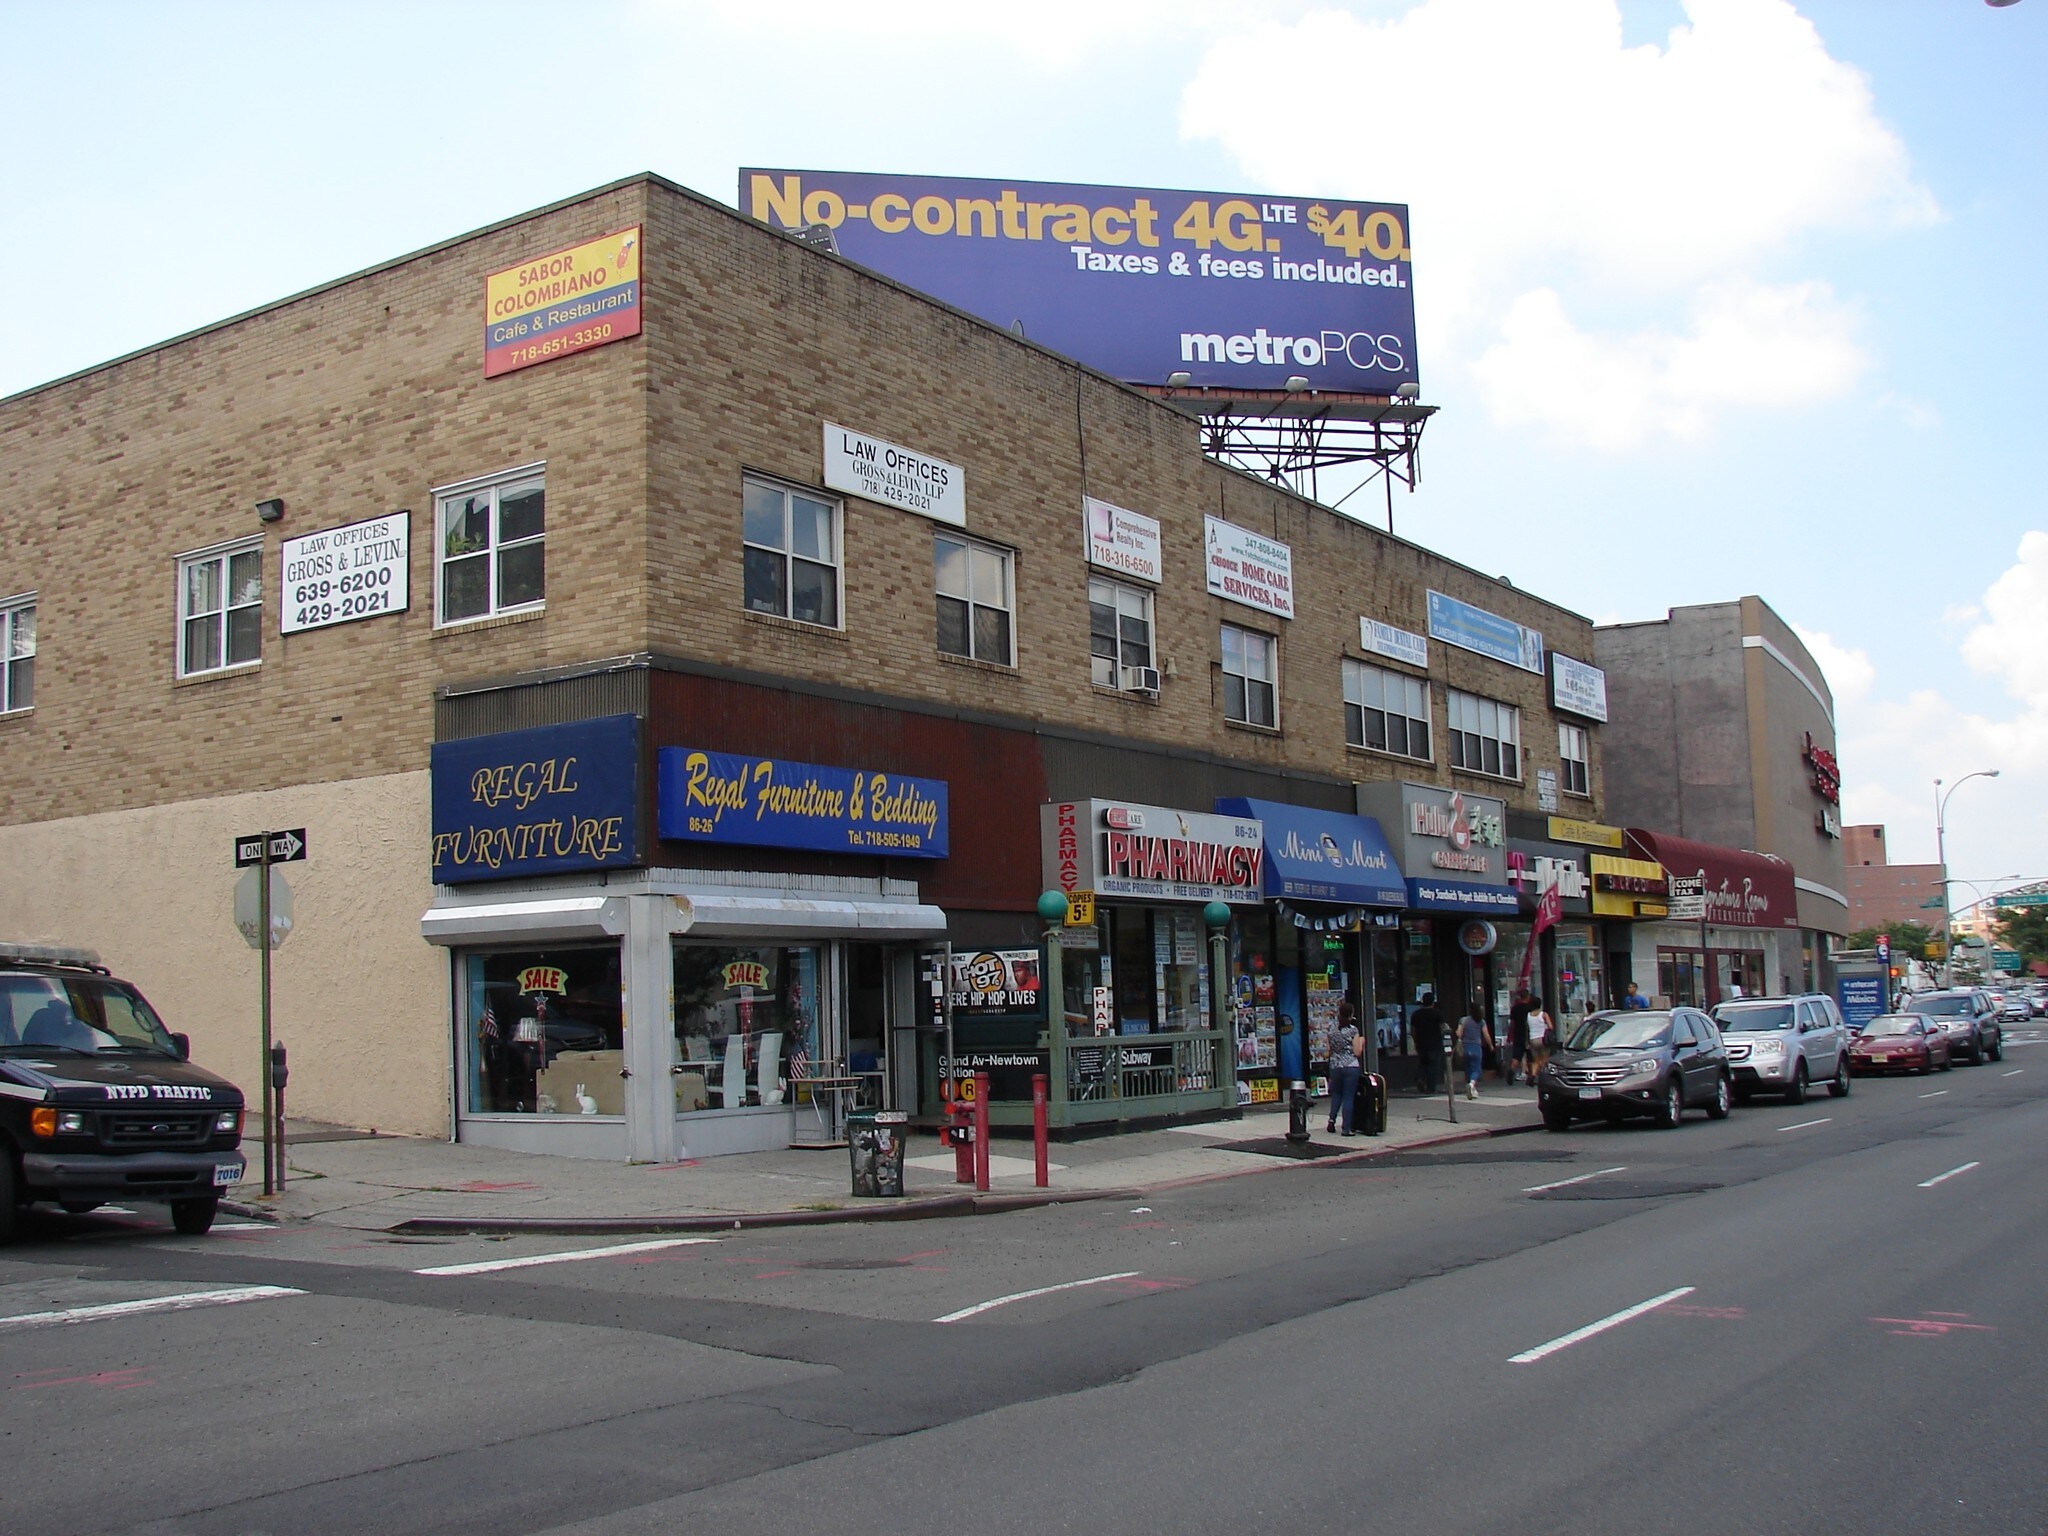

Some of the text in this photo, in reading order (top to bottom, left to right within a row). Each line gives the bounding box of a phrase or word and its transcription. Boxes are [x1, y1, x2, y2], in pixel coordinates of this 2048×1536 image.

[751, 175, 1411, 262] No-contract 4G. LTE $40.
[519, 255, 573, 287] SABOR
[1071, 245, 1405, 289] Taxes & fees included.
[494, 267, 607, 316] COLOMBIANO
[494, 289, 632, 343] Cafe & Restaurant
[511, 324, 612, 364] 718-651-3330
[843, 433, 948, 486] LAW OFFICES
[861, 479, 930, 510] (718) 429-2021
[925, 483, 944, 500] LLP
[301, 522, 389, 555] LAW OFFICES
[1116, 517, 1157, 541] Comprehensive
[1116, 531, 1146, 550] Realty Inc.
[287, 554, 333, 582] GROSS
[338, 552, 348, 571] &
[354, 538, 401, 567] LEVIN
[1094, 545, 1153, 576] 718-316-6500
[296, 567, 392, 603] 639-6200
[1211, 555, 1289, 592] CHOICE HOME CARE
[1224, 576, 1290, 611] SERVICES, Inc.
[297, 590, 389, 625] 429-2021
[471, 757, 578, 810] REGAL
[685, 753, 938, 839] Regal Furniture & Bedding
[689, 817, 713, 833] 86-26
[1234, 825, 1258, 840] 86-24
[245, 839, 295, 857] ON WAY
[432, 815, 623, 869] FURNITURE
[848, 830, 920, 848] Tel. 718-505-1949
[1058, 805, 1077, 892] PHARMACY
[1278, 830, 1387, 870] Mini Mart
[1107, 832, 1262, 887] PHARMACY
[1103, 880, 1131, 893] ORGANIC
[1132, 882, 1163, 895] PRODUCTS
[1173, 885, 1187, 896] FREE
[1188, 886, 1213, 899] DELIVERY
[1675, 888, 1694, 896] TAX
[1676, 878, 1702, 888] COME
[1068, 894, 1092, 904] COPIES
[524, 967, 559, 991] SALE
[728, 961, 762, 987] SALE
[960, 957, 999, 981] HOT
[976, 971, 1001, 988] 97
[949, 989, 1036, 1006] ERE HIP HOP LIVES
[1095, 989, 1106, 1037] PHAR
[939, 1054, 1039, 1066] Gand Av-Newtown
[1122, 1050, 1151, 1065] Subway
[939, 1067, 975, 1077] Sation
[1261, 1080, 1274, 1089] Accept
[106, 1085, 212, 1100] NYPD TRAFFIC
[965, 1083, 974, 1096] R
[1251, 1089, 1261, 1100] EBT
[1263, 1087, 1278, 1100] Cards
[216, 1168, 240, 1181] 7016
